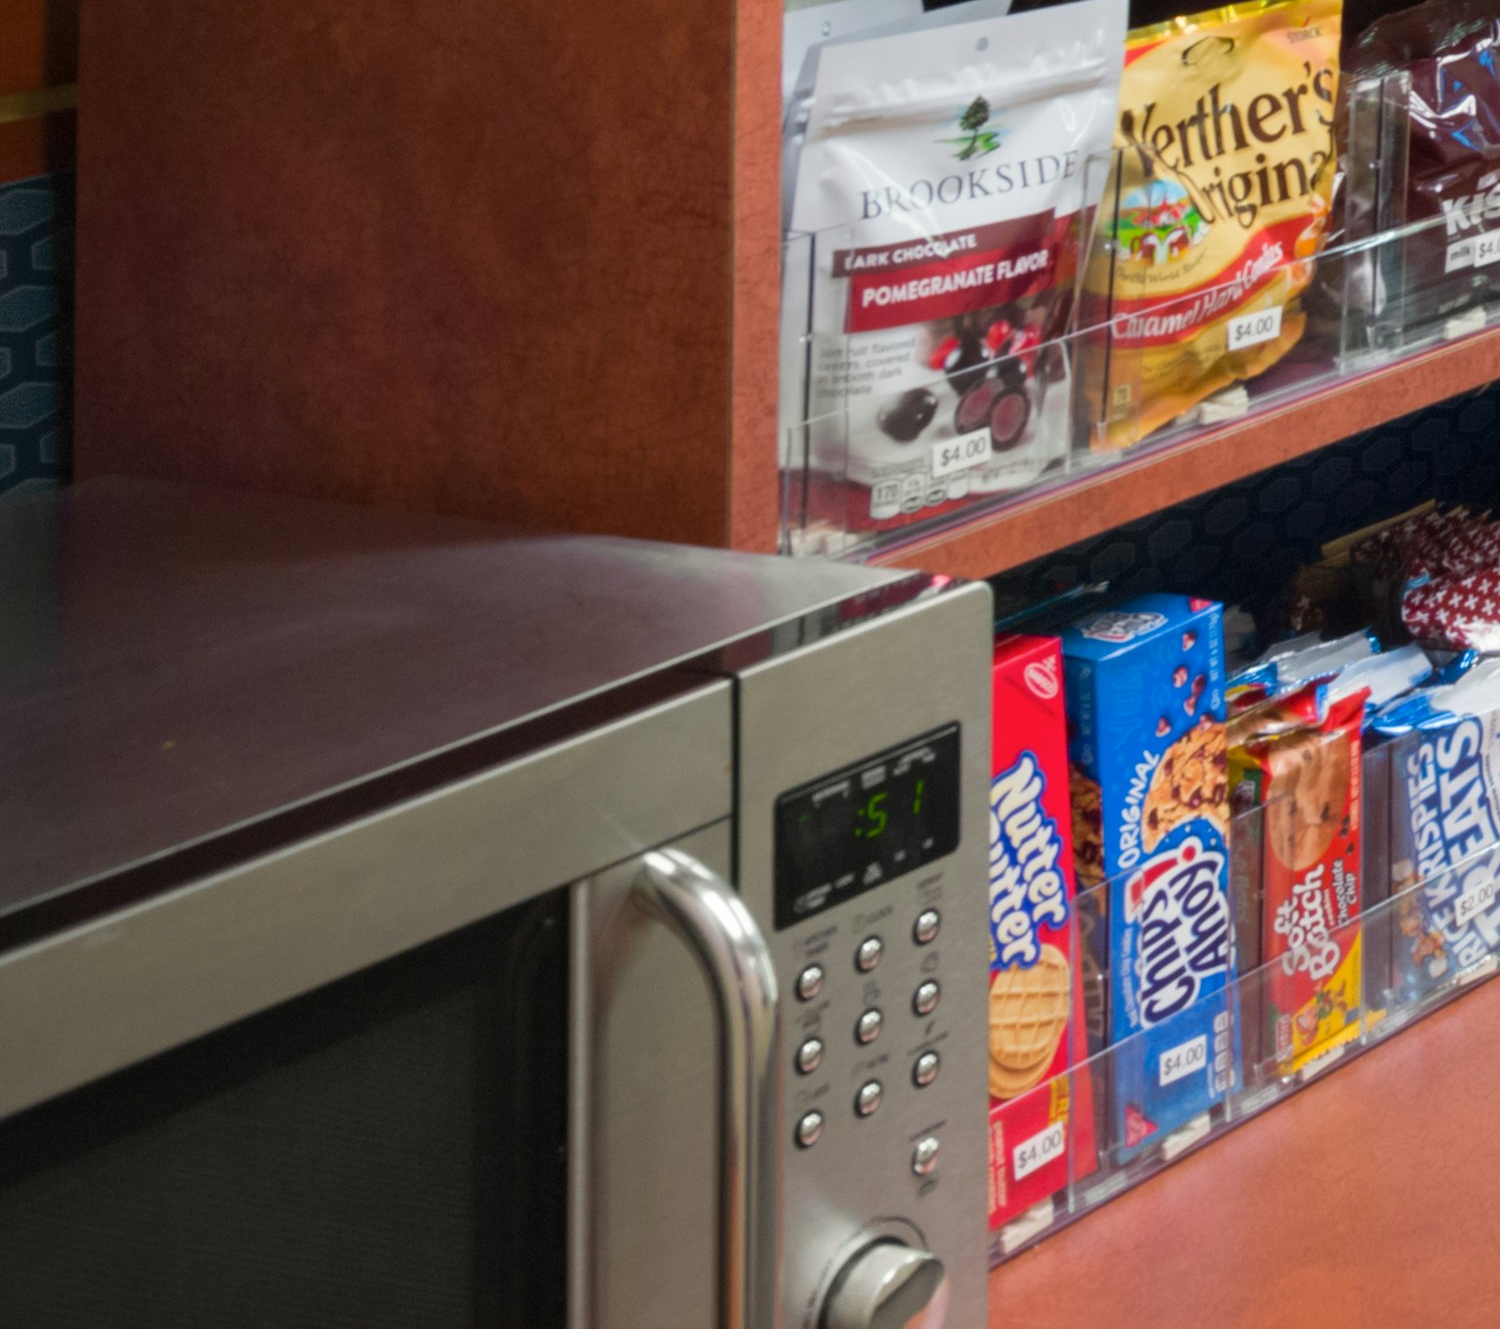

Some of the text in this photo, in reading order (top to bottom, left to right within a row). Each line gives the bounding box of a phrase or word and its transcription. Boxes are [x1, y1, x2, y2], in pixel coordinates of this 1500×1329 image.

[857, 150, 1079, 221] BROOKSIDE
[861, 249, 1048, 309] POMEGRANATE FLAVOR
[1234, 316, 1275, 340] $4.00
[940, 437, 987, 466] $4.00
[1117, 749, 1160, 868] ORIGINAL
[1459, 886, 1495, 912] $2.00
[1162, 1042, 1205, 1076] $4.00
[1017, 1128, 1064, 1171] $4.00
